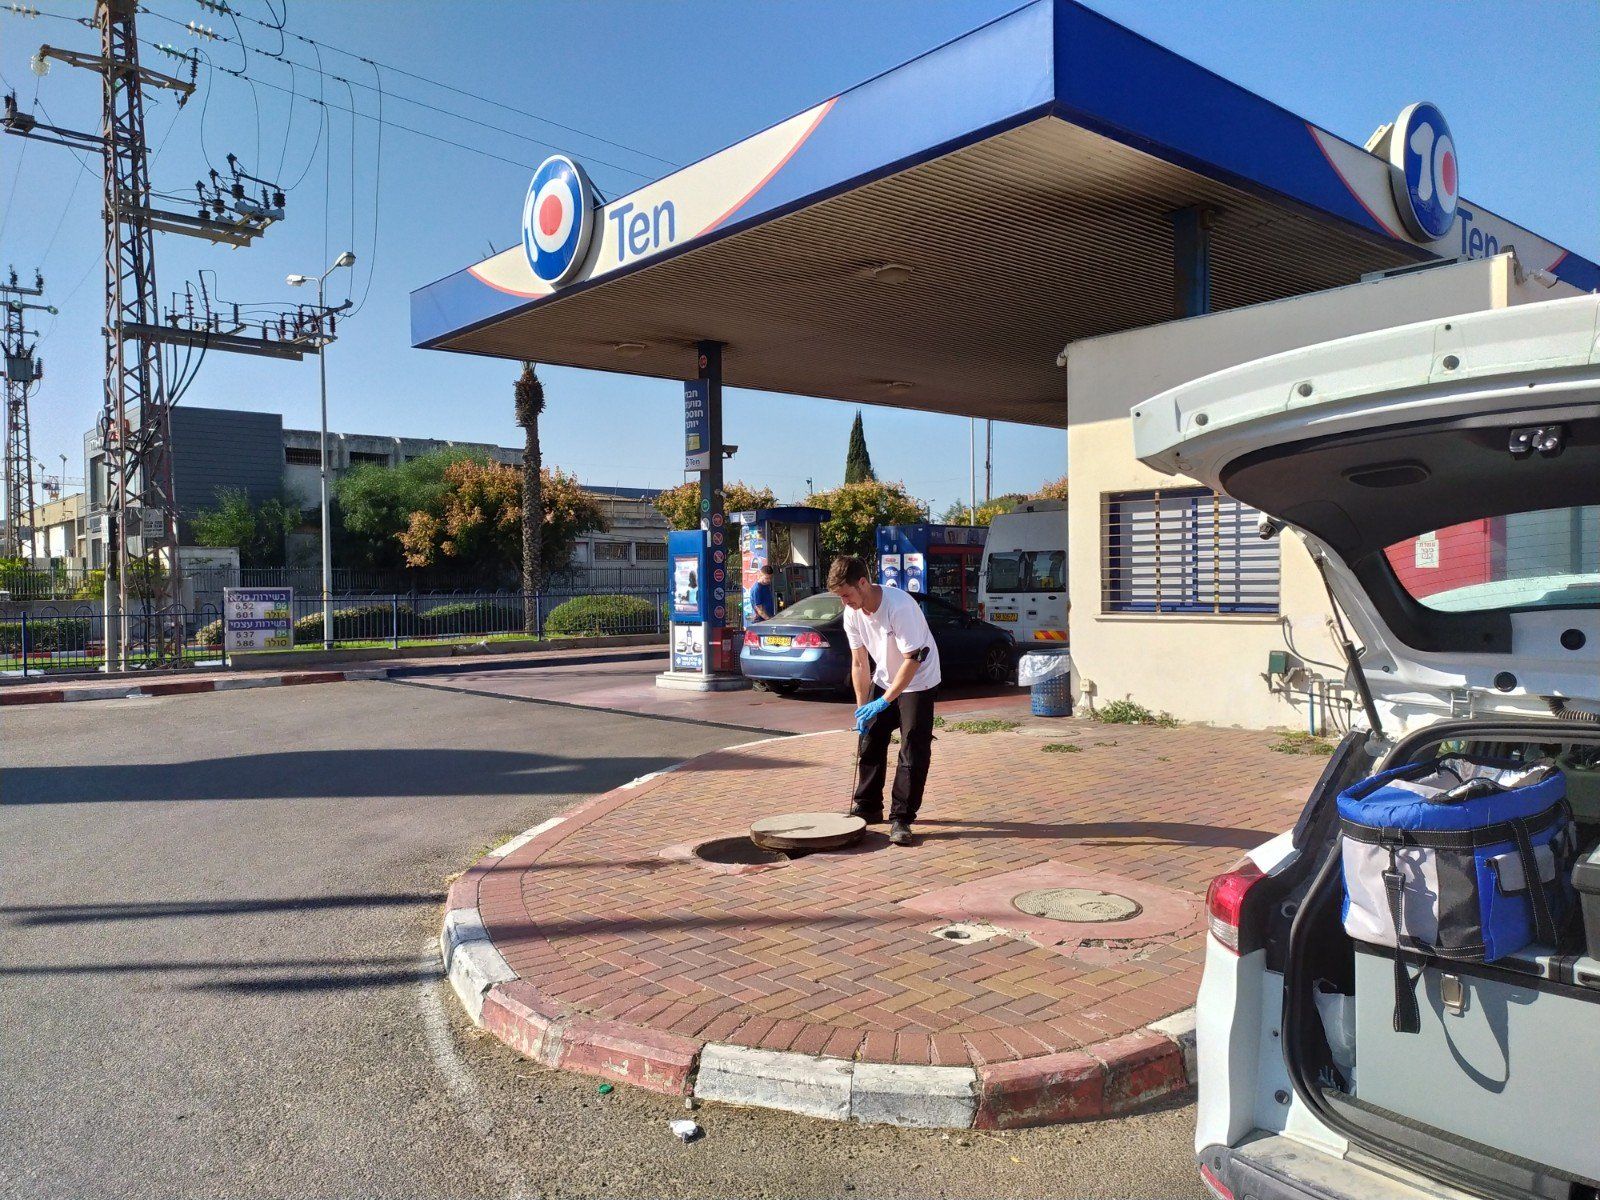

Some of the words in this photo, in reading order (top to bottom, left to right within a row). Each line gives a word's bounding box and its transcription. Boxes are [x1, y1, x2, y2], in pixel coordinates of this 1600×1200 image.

[608, 200, 676, 262] Ten
[1456, 206, 1499, 259] Ten
[252, 593, 286, 601] בשירות
[276, 602, 287, 610] 95
[264, 611, 287, 619] סולר
[229, 621, 253, 629] עצמי
[264, 638, 287, 647] סולר
